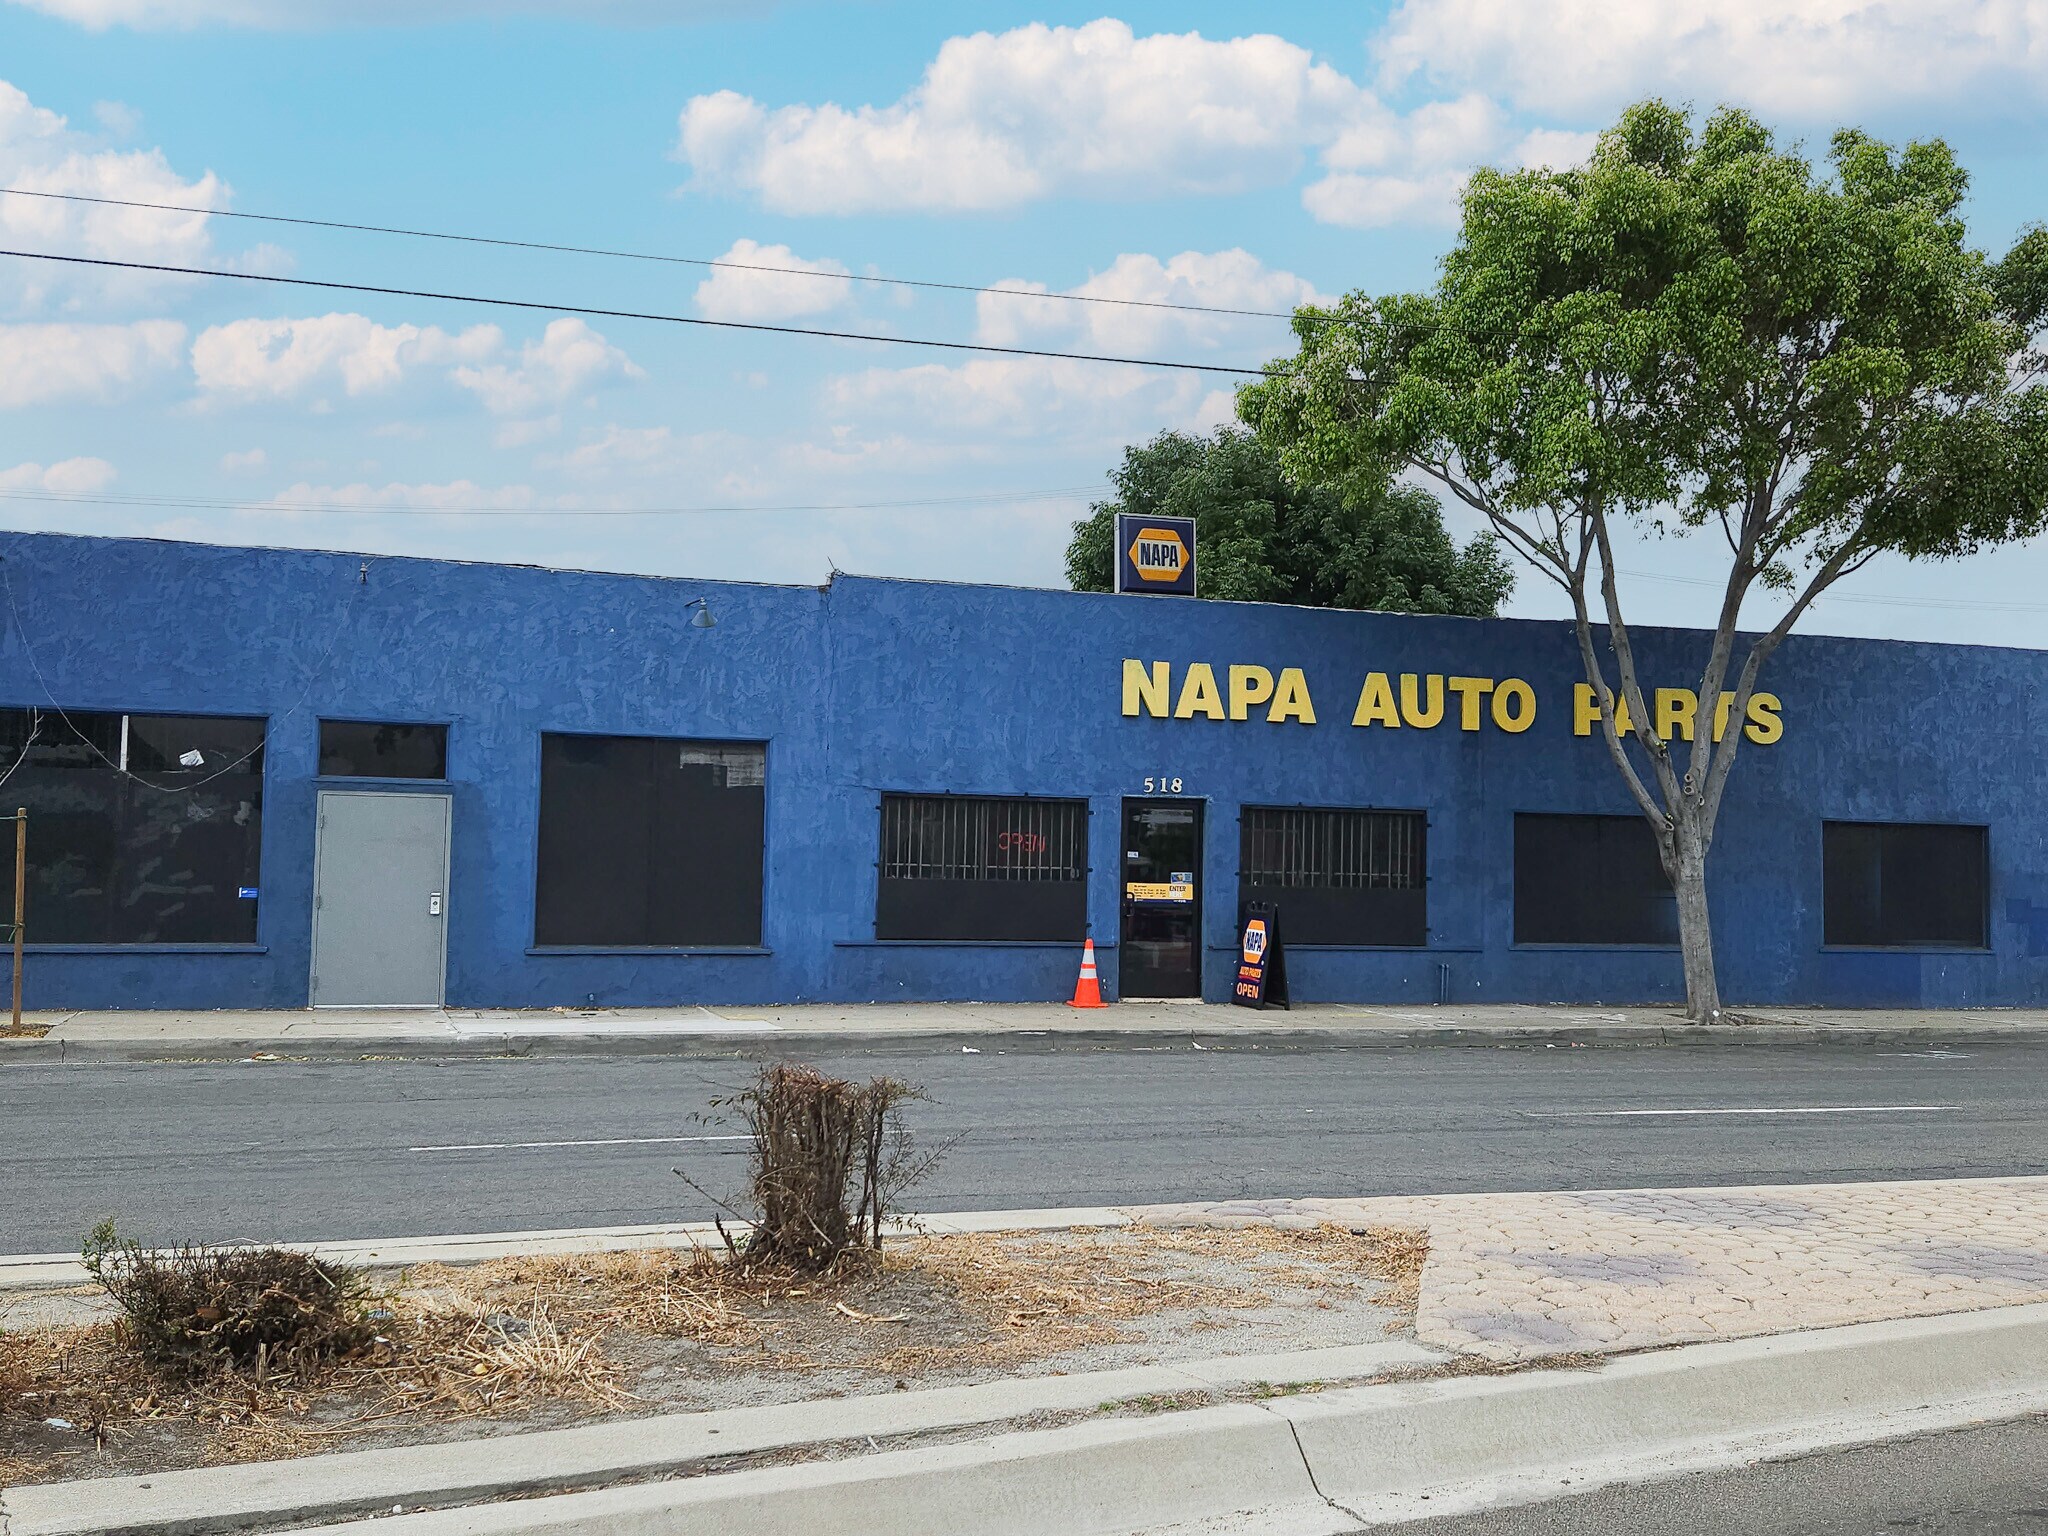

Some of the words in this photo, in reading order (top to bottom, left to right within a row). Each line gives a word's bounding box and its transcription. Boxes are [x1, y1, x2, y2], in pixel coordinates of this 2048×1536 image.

[1140, 542, 1179, 568] NAPA
[1121, 657, 1317, 724] NAPA
[1351, 672, 1536, 733] AUTO
[1143, 777, 1183, 793] 518
[998, 832, 1046, 853] OPEN
[1245, 931, 1263, 952] NAPA
[1236, 982, 1259, 999] OPEN
